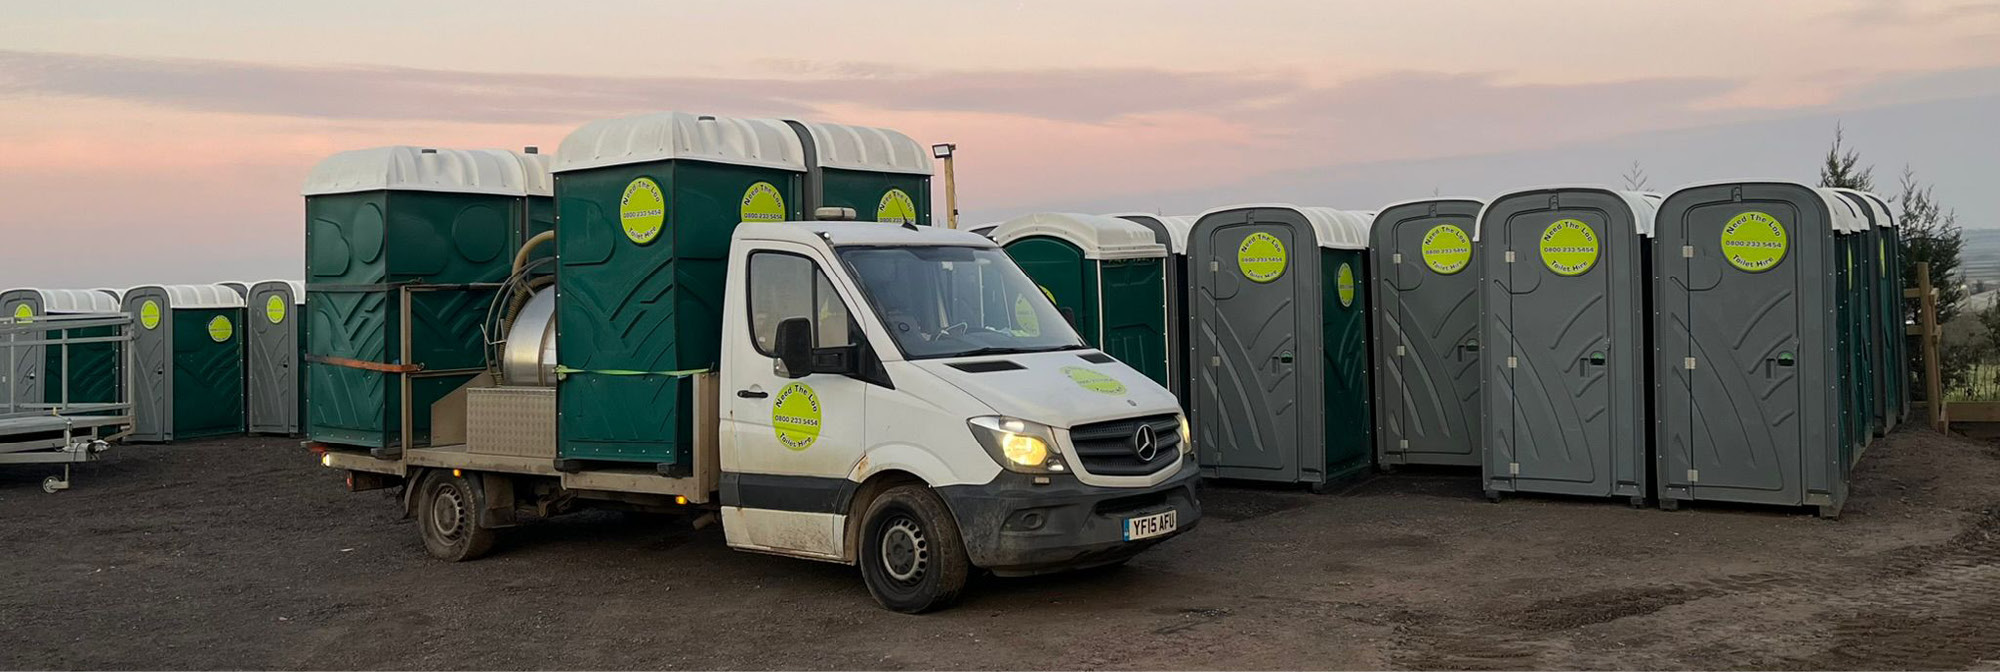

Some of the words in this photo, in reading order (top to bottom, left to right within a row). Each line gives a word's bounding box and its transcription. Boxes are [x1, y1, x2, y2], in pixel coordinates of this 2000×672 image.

[623, 183, 637, 206] Need
[638, 181, 650, 189] The
[650, 186, 660, 202] Loo
[1544, 224, 1563, 242] Need
[1565, 221, 1580, 229] The
[1581, 228, 1593, 242] Loo
[1726, 216, 1747, 235] Need
[1750, 214, 1767, 222] The
[1768, 221, 1781, 237] Loo
[1425, 229, 1440, 245] Need
[1455, 231, 1466, 243] Loo
[1552, 260, 1570, 272] Toilet
[1573, 262, 1587, 270] Hire
[1733, 254, 1753, 267] Toilet
[1756, 257, 1774, 267] Hire
[775, 386, 792, 408] Need
[794, 384, 808, 395] The
[808, 393, 817, 412] Loo
[780, 432, 796, 447] Toilet
[797, 437, 811, 447] Hire
[1133, 517, 1157, 536] YF15
[1159, 512, 1175, 531] AFU
